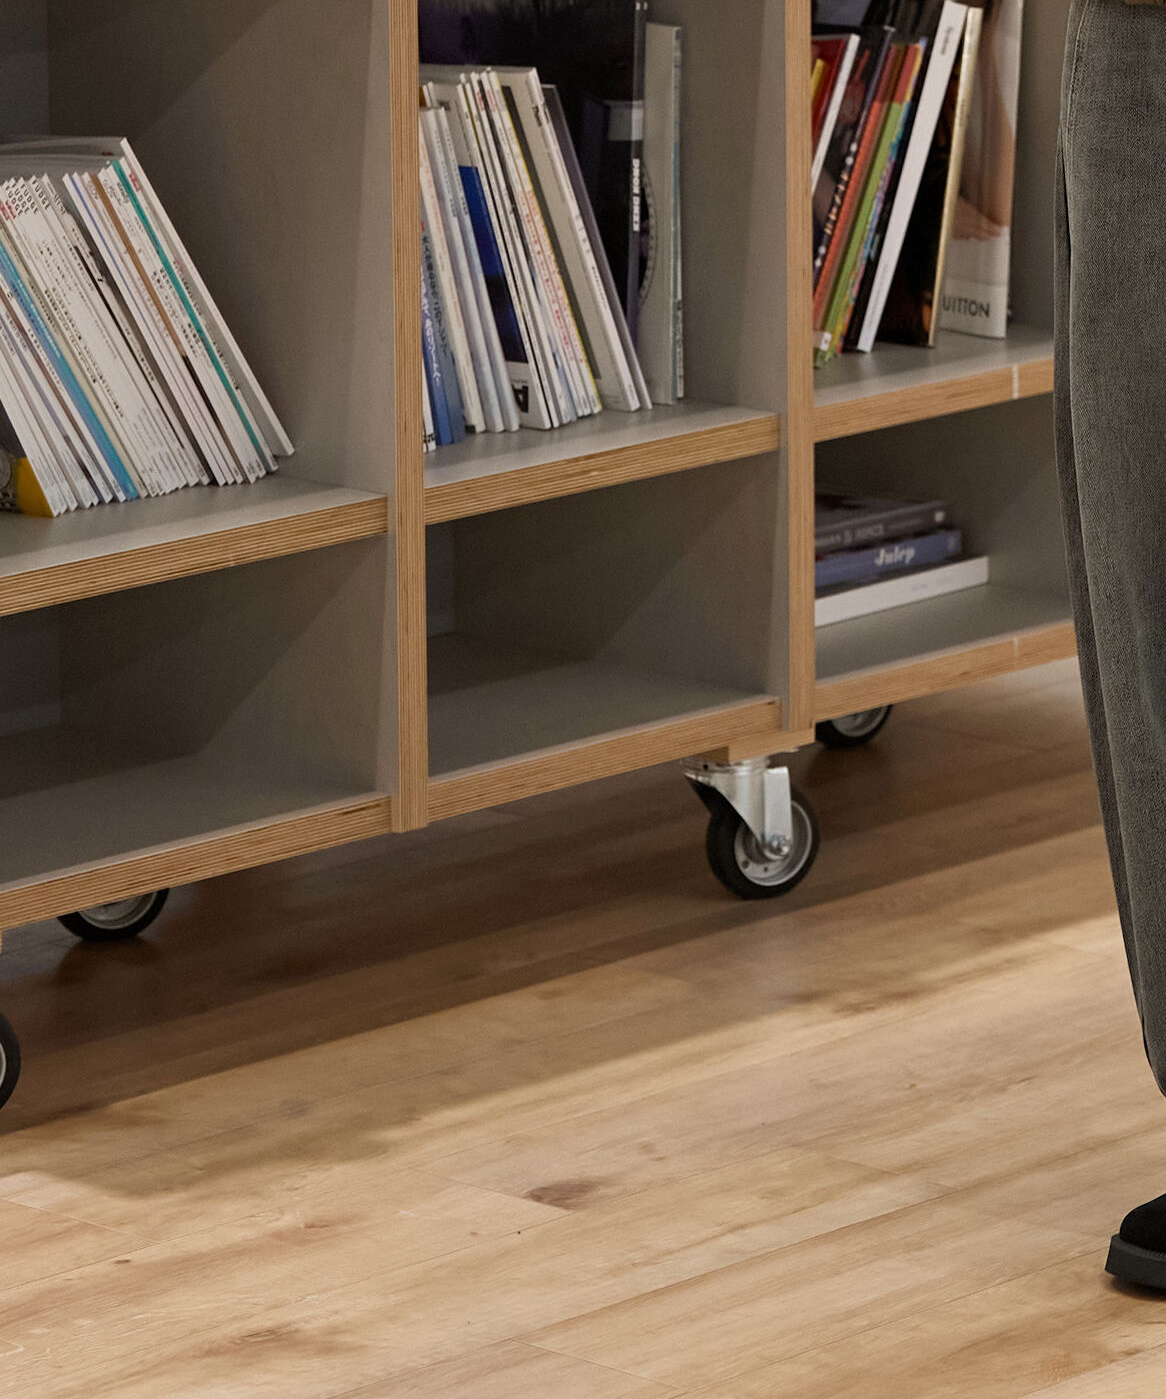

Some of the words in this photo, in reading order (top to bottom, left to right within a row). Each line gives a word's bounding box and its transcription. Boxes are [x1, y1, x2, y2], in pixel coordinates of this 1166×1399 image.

[5, 185, 23, 217] FUDGE
[11, 182, 30, 214] FUDGE
[20, 183, 38, 214] FUDGE
[32, 179, 50, 210] FUDGE
